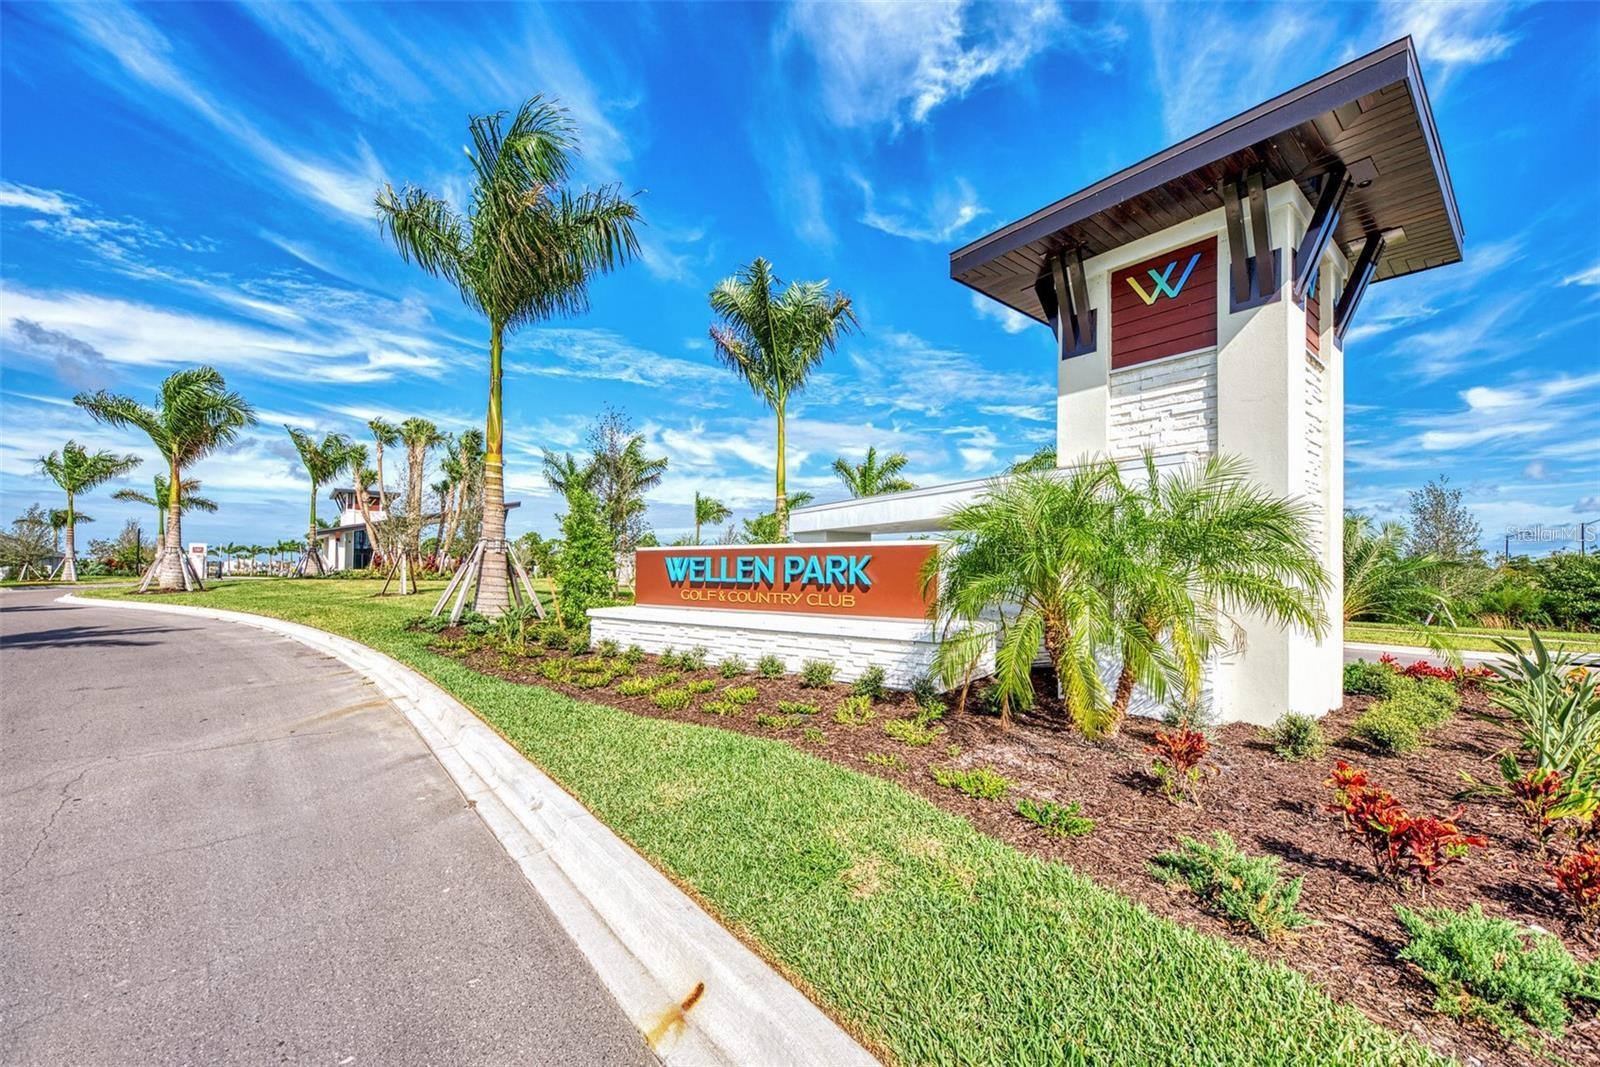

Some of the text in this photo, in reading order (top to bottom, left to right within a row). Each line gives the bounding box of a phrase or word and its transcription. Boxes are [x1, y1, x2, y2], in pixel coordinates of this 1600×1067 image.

[664, 554, 873, 588] WELLEN PARK
[680, 589, 856, 607] GOLF & COUNTRY CLUB
